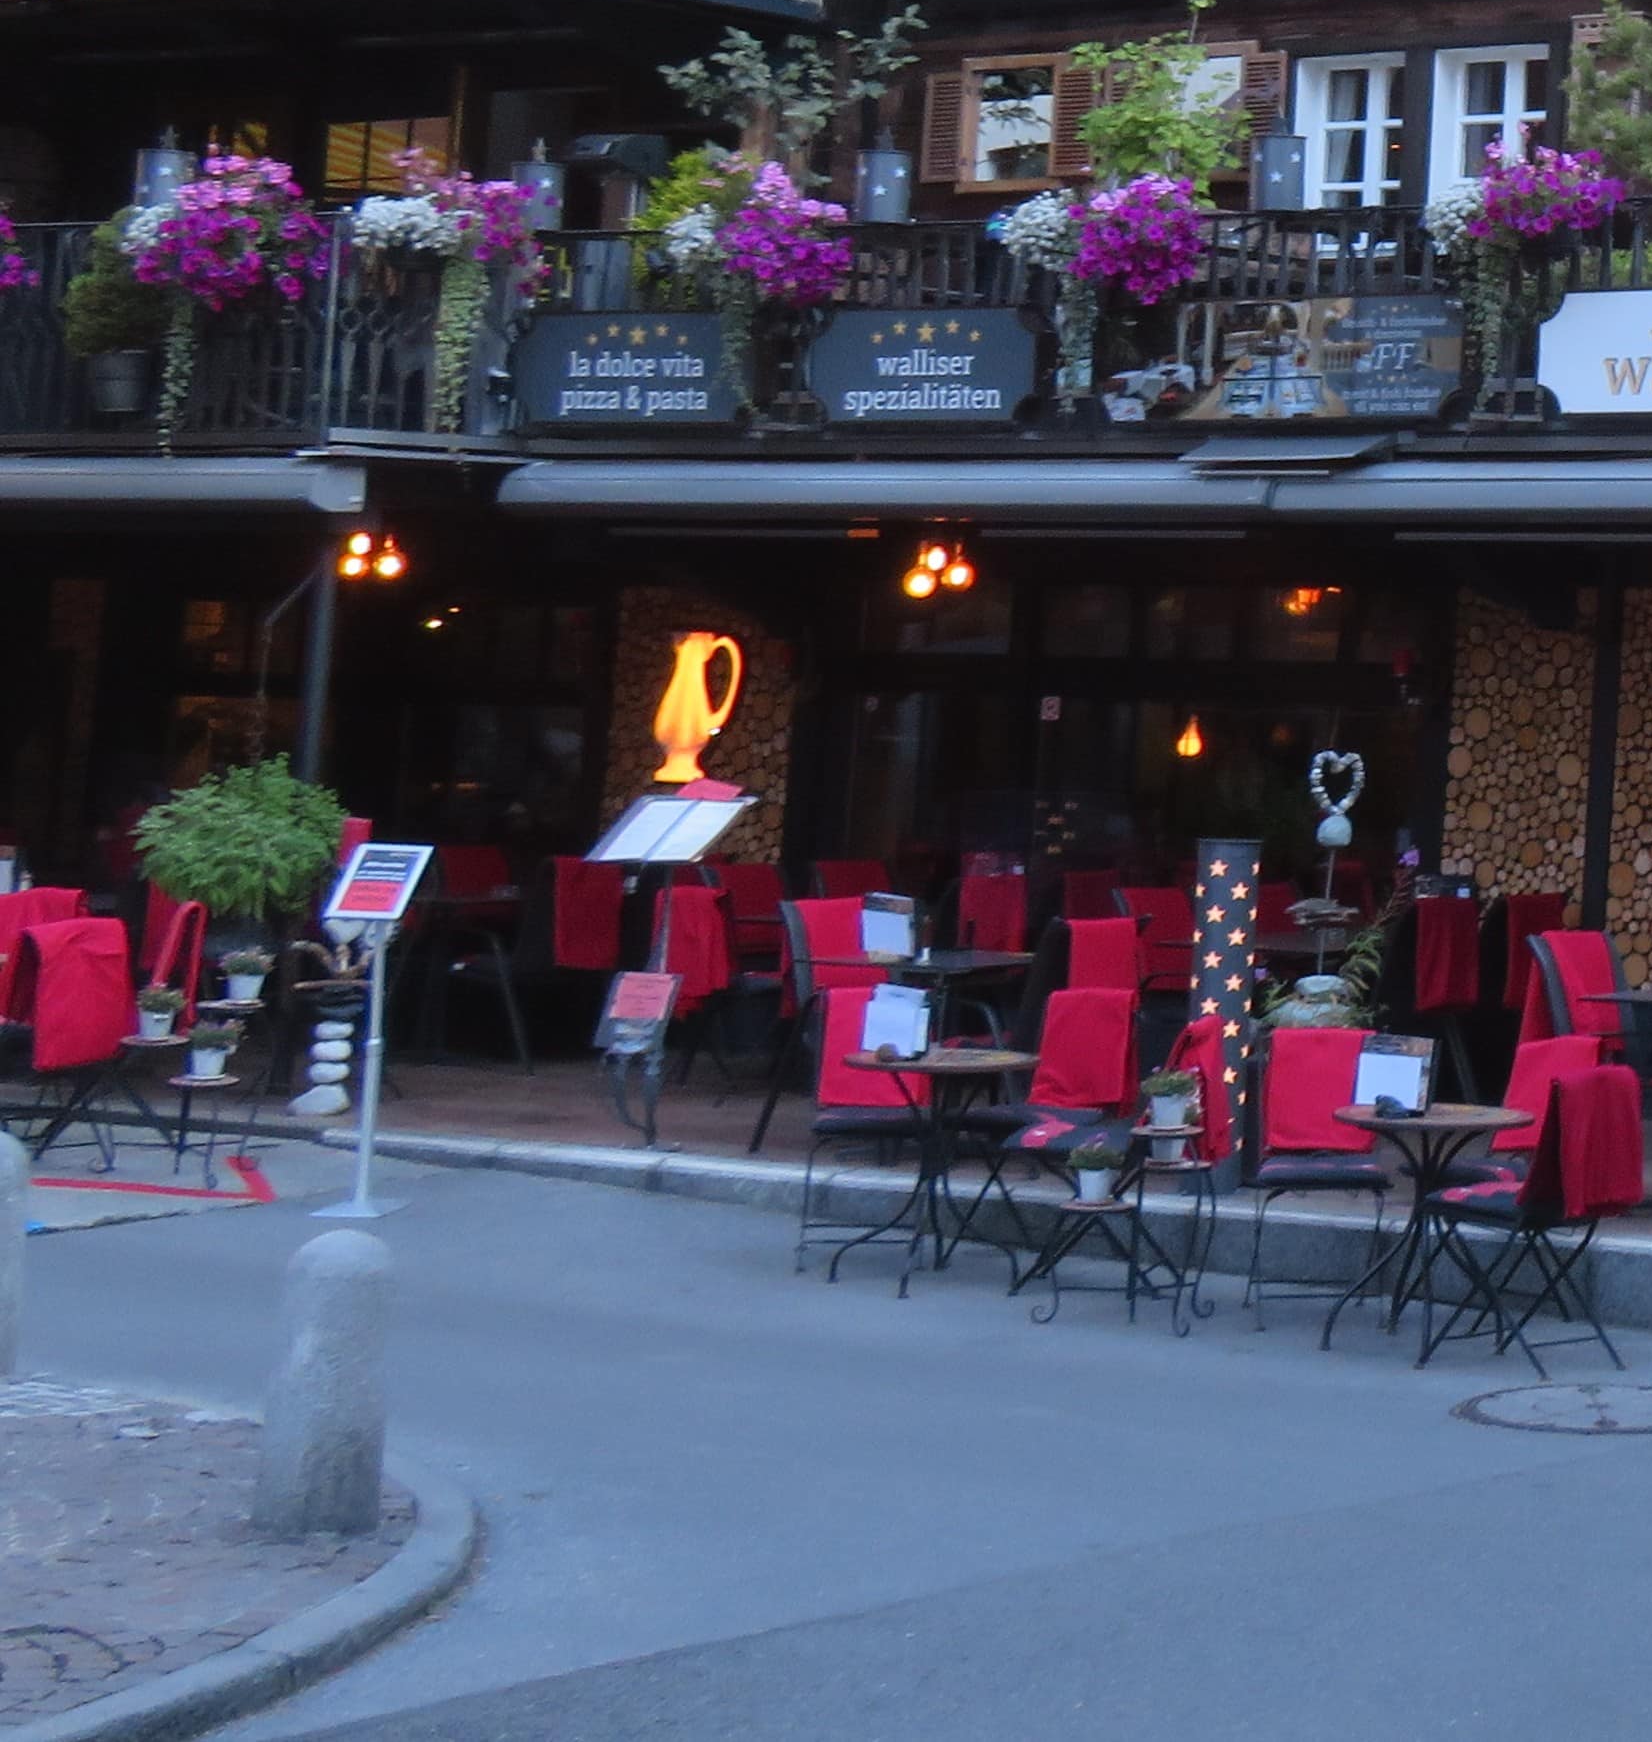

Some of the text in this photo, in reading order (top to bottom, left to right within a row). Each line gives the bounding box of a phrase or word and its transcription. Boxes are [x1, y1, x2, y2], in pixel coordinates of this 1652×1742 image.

[568, 350, 705, 378] la dolce vita
[876, 348, 976, 377] walliser
[559, 384, 709, 417] pizza & pasta
[843, 383, 1001, 418] spezialitäten
